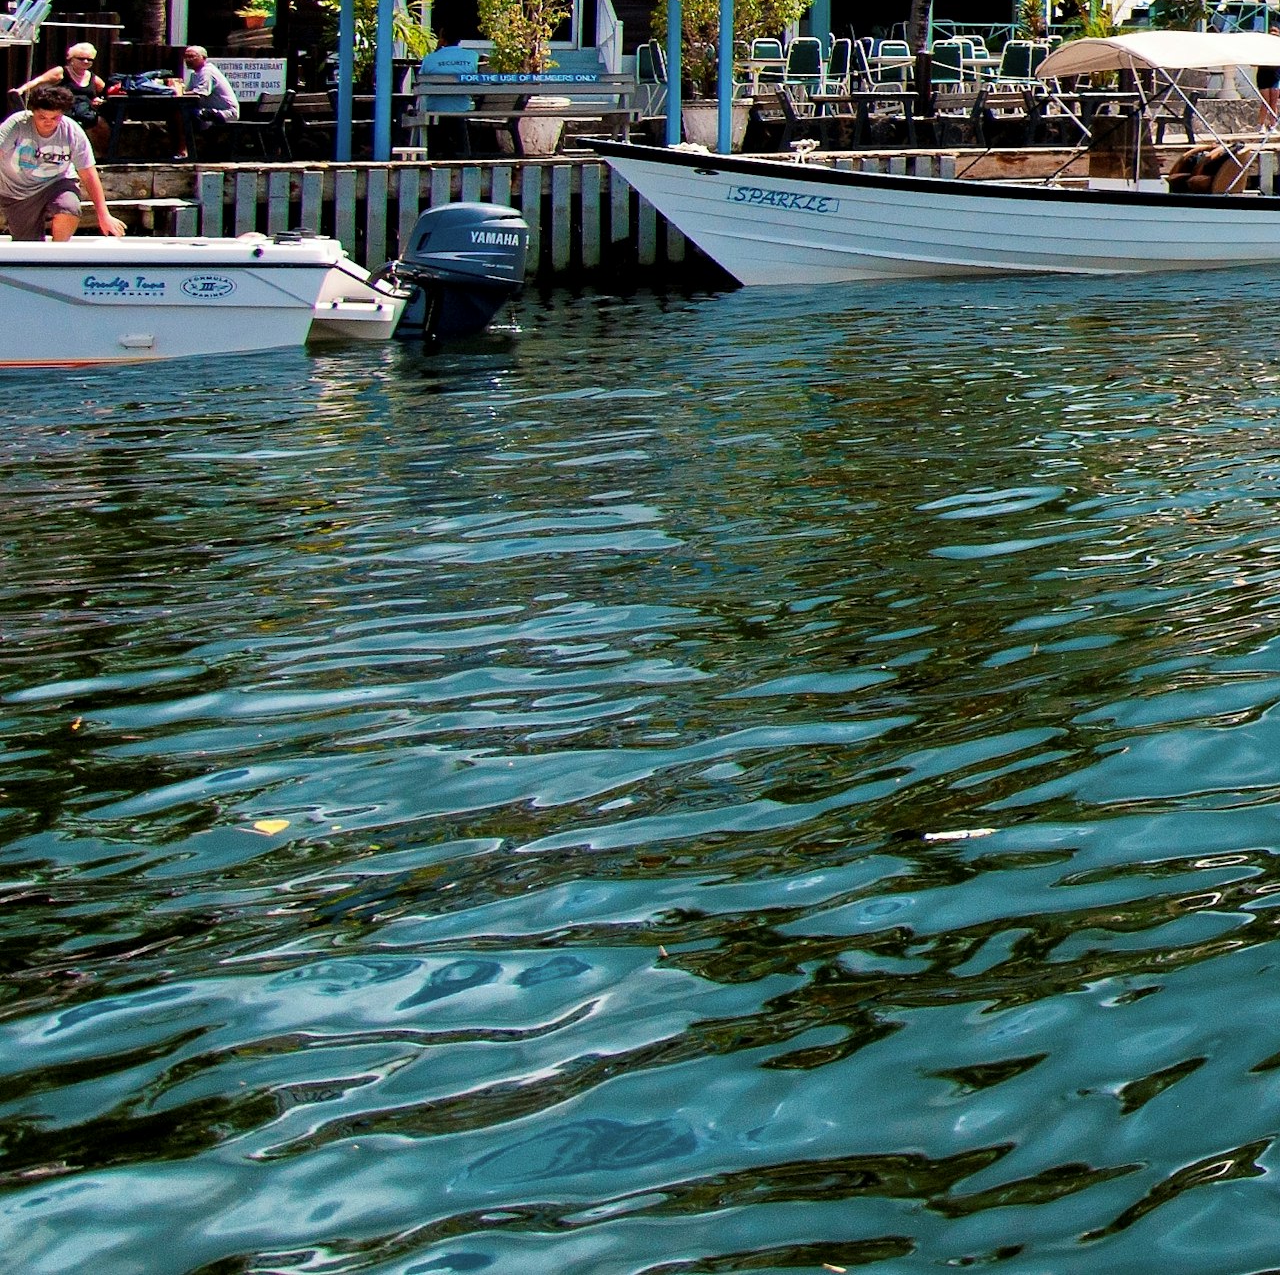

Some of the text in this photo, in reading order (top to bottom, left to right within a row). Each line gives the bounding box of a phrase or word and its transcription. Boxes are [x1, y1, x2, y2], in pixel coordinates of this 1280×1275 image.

[575, 74, 597, 82] ONLY
[734, 186, 833, 213] SPARKLE
[471, 230, 519, 246] YAMAHA
